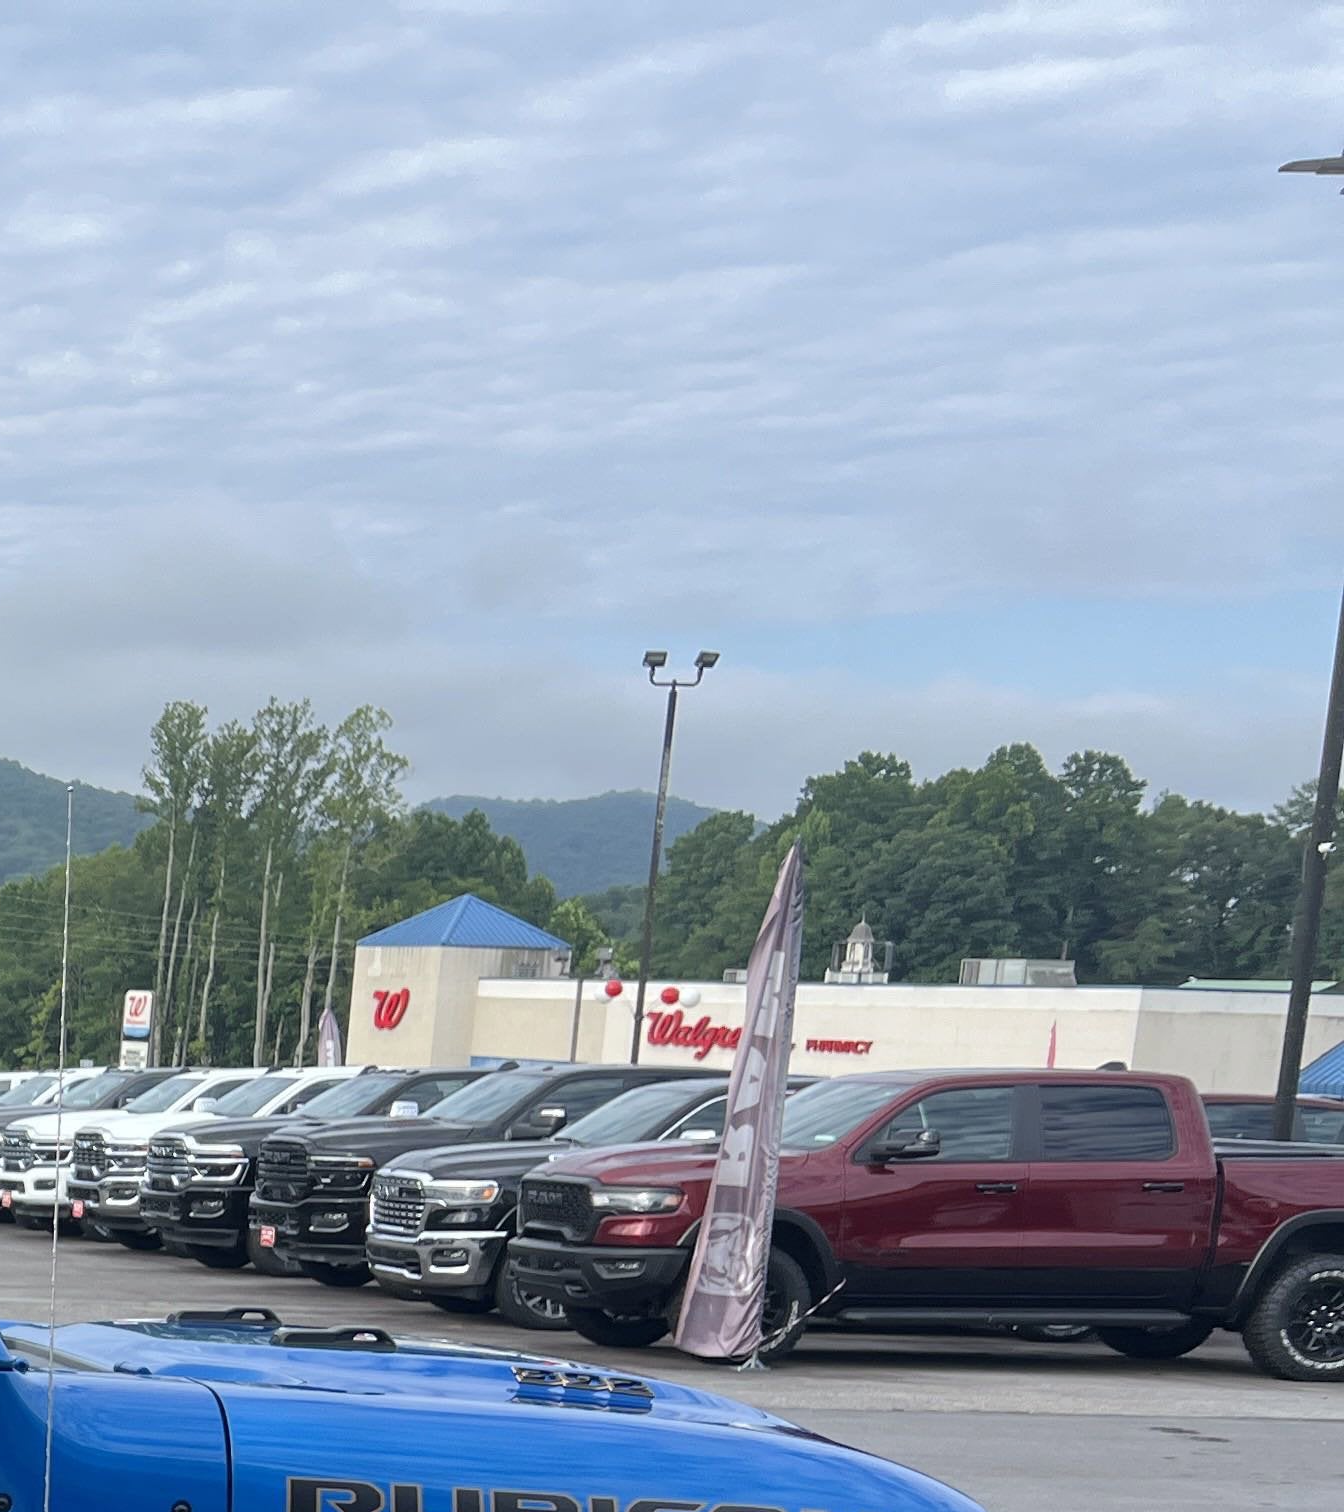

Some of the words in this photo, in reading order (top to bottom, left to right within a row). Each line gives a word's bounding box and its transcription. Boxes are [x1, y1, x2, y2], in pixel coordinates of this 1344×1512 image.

[129, 995, 147, 1017] W
[373, 988, 410, 1030] W
[646, 1009, 796, 1061] Walgre
